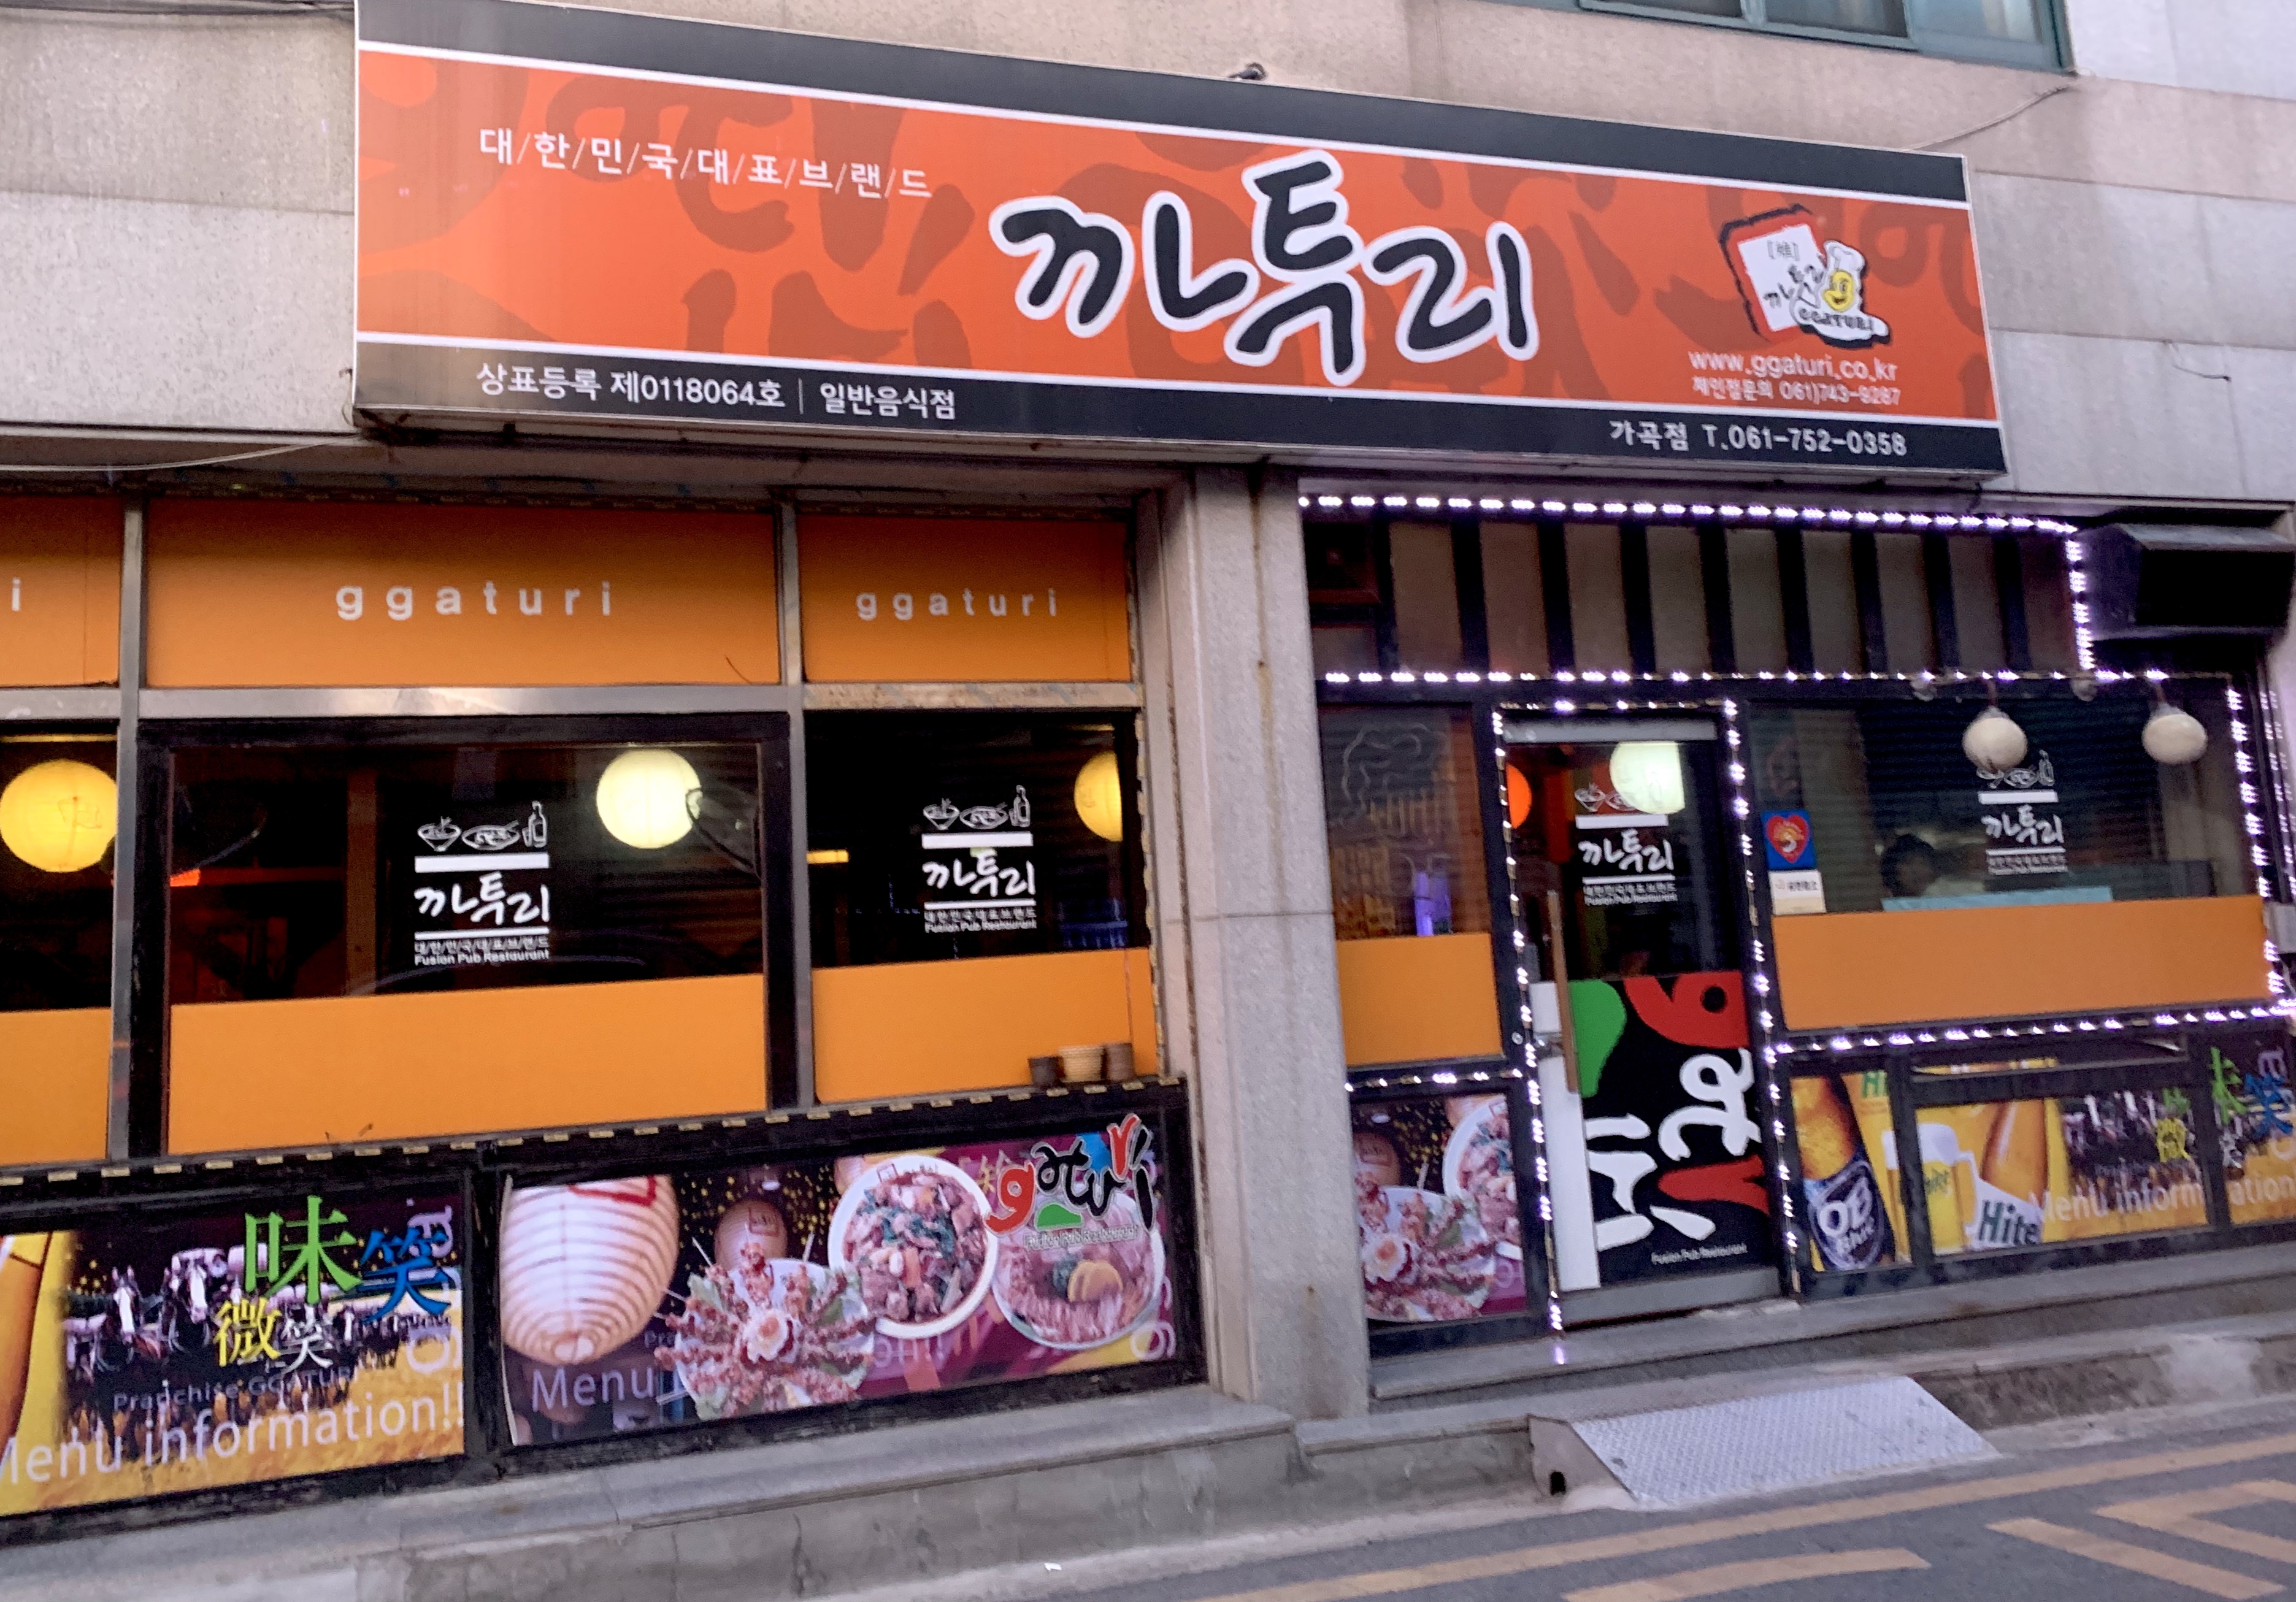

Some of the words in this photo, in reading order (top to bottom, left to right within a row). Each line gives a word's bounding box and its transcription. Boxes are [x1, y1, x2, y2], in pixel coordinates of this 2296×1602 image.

[1688, 351, 1898, 381] www.ggaturi.co.kr
[477, 363, 602, 401] 상표등록
[610, 371, 785, 407] 제0118064호
[820, 382, 957, 420] 일반음식점
[1610, 420, 1689, 451] 가곡점
[1702, 424, 1906, 456] T.061-752-0358
[336, 580, 612, 621] ggaturi
[856, 588, 1057, 621] ggaturi
[532, 1366, 656, 1411] Menu
